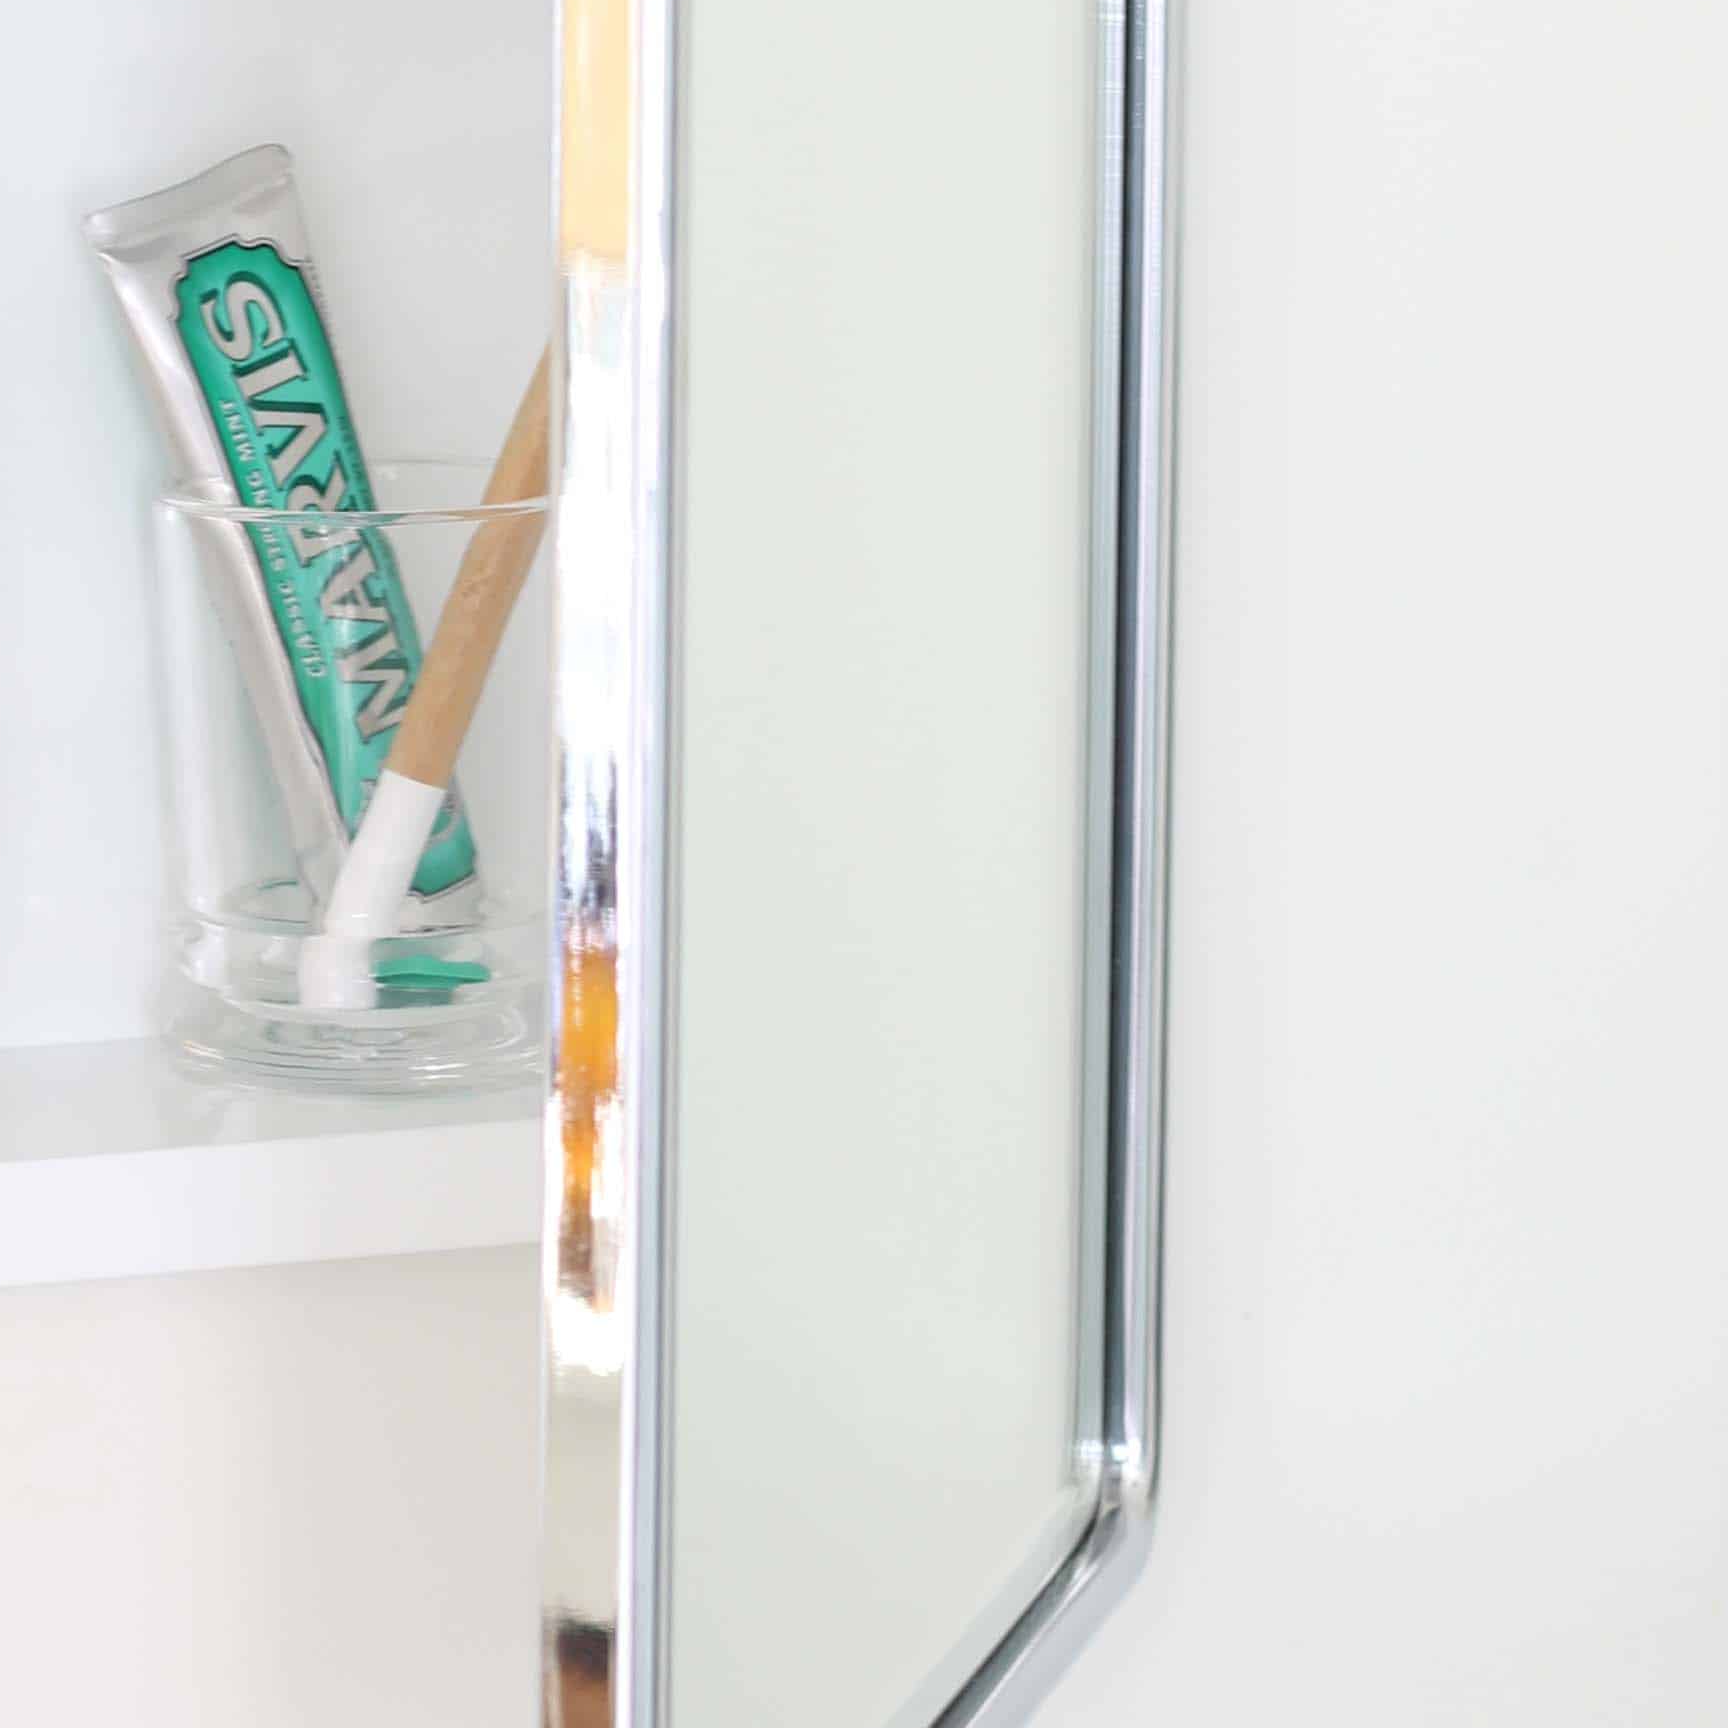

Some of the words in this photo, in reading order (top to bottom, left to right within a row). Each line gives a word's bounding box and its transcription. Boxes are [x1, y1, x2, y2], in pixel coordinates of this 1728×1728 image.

[218, 398, 255, 462] MINT
[198, 270, 416, 746] MARVIS
[277, 580, 328, 679] CLASSIC
